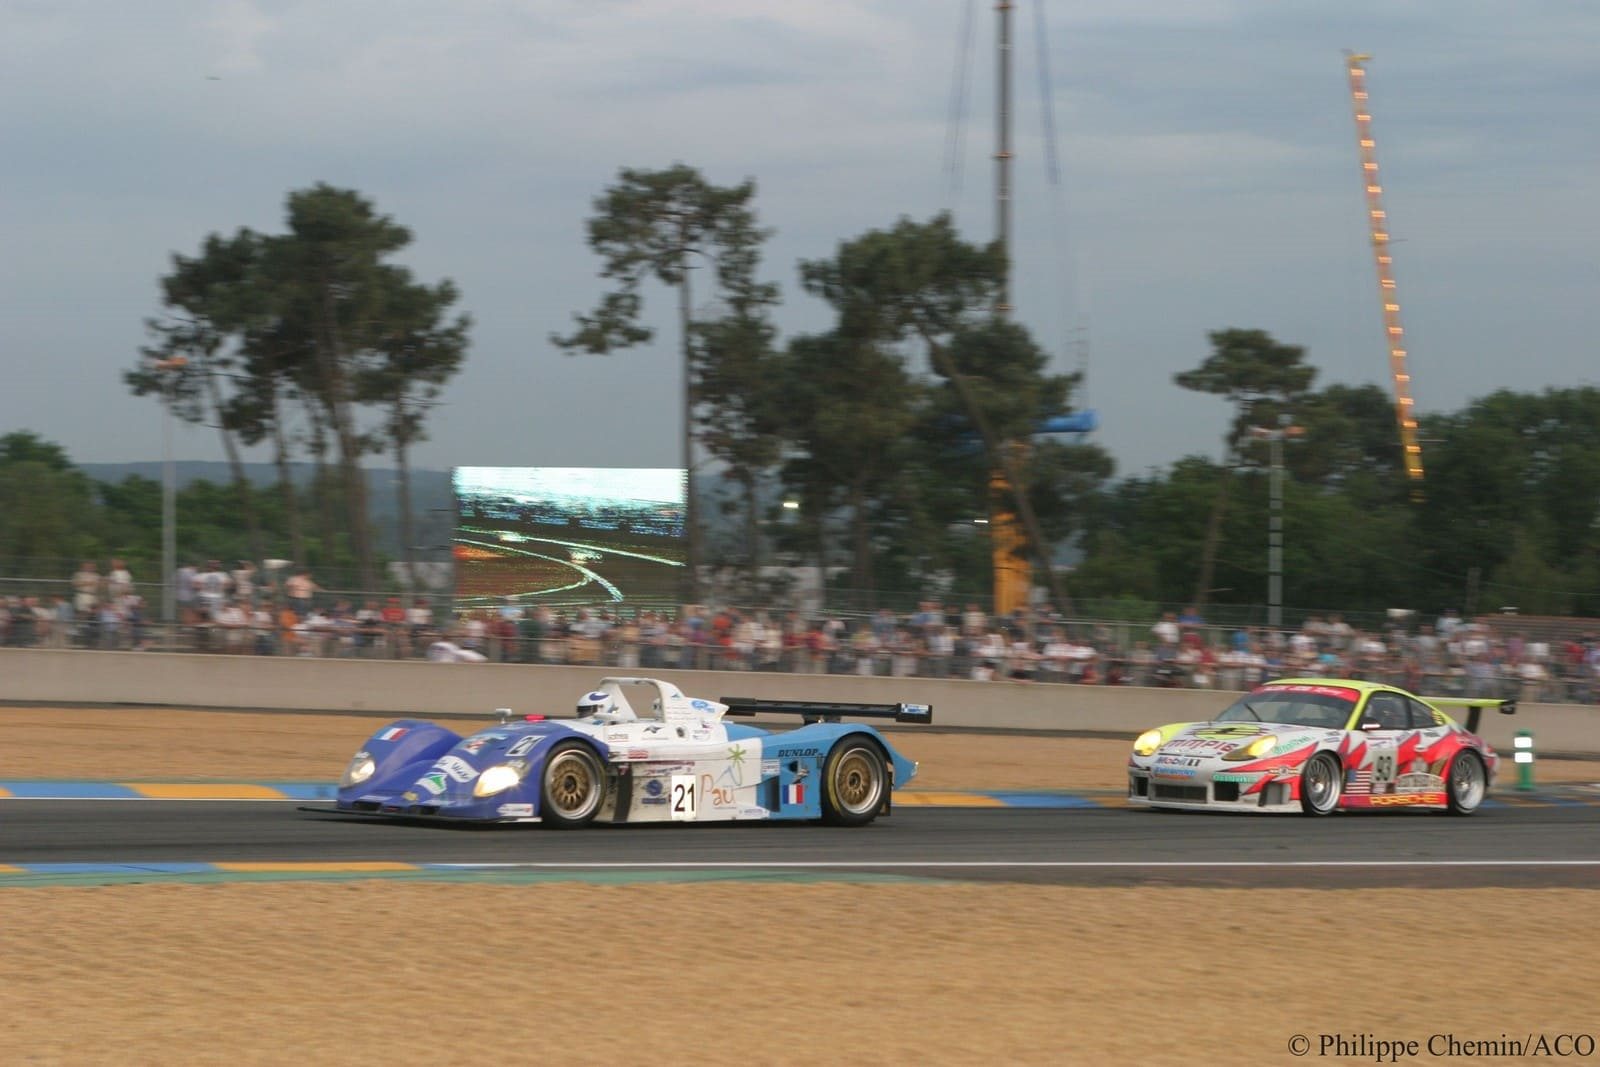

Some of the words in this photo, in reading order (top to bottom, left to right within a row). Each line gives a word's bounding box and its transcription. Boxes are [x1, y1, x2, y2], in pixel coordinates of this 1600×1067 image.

[509, 737, 544, 754] 21
[778, 748, 818, 758] DUNLOP
[1156, 757, 1187, 766] Mobil
[674, 783, 695, 812] 21
[699, 774, 736, 809] Pau
[1370, 794, 1440, 806] PORSCHE
